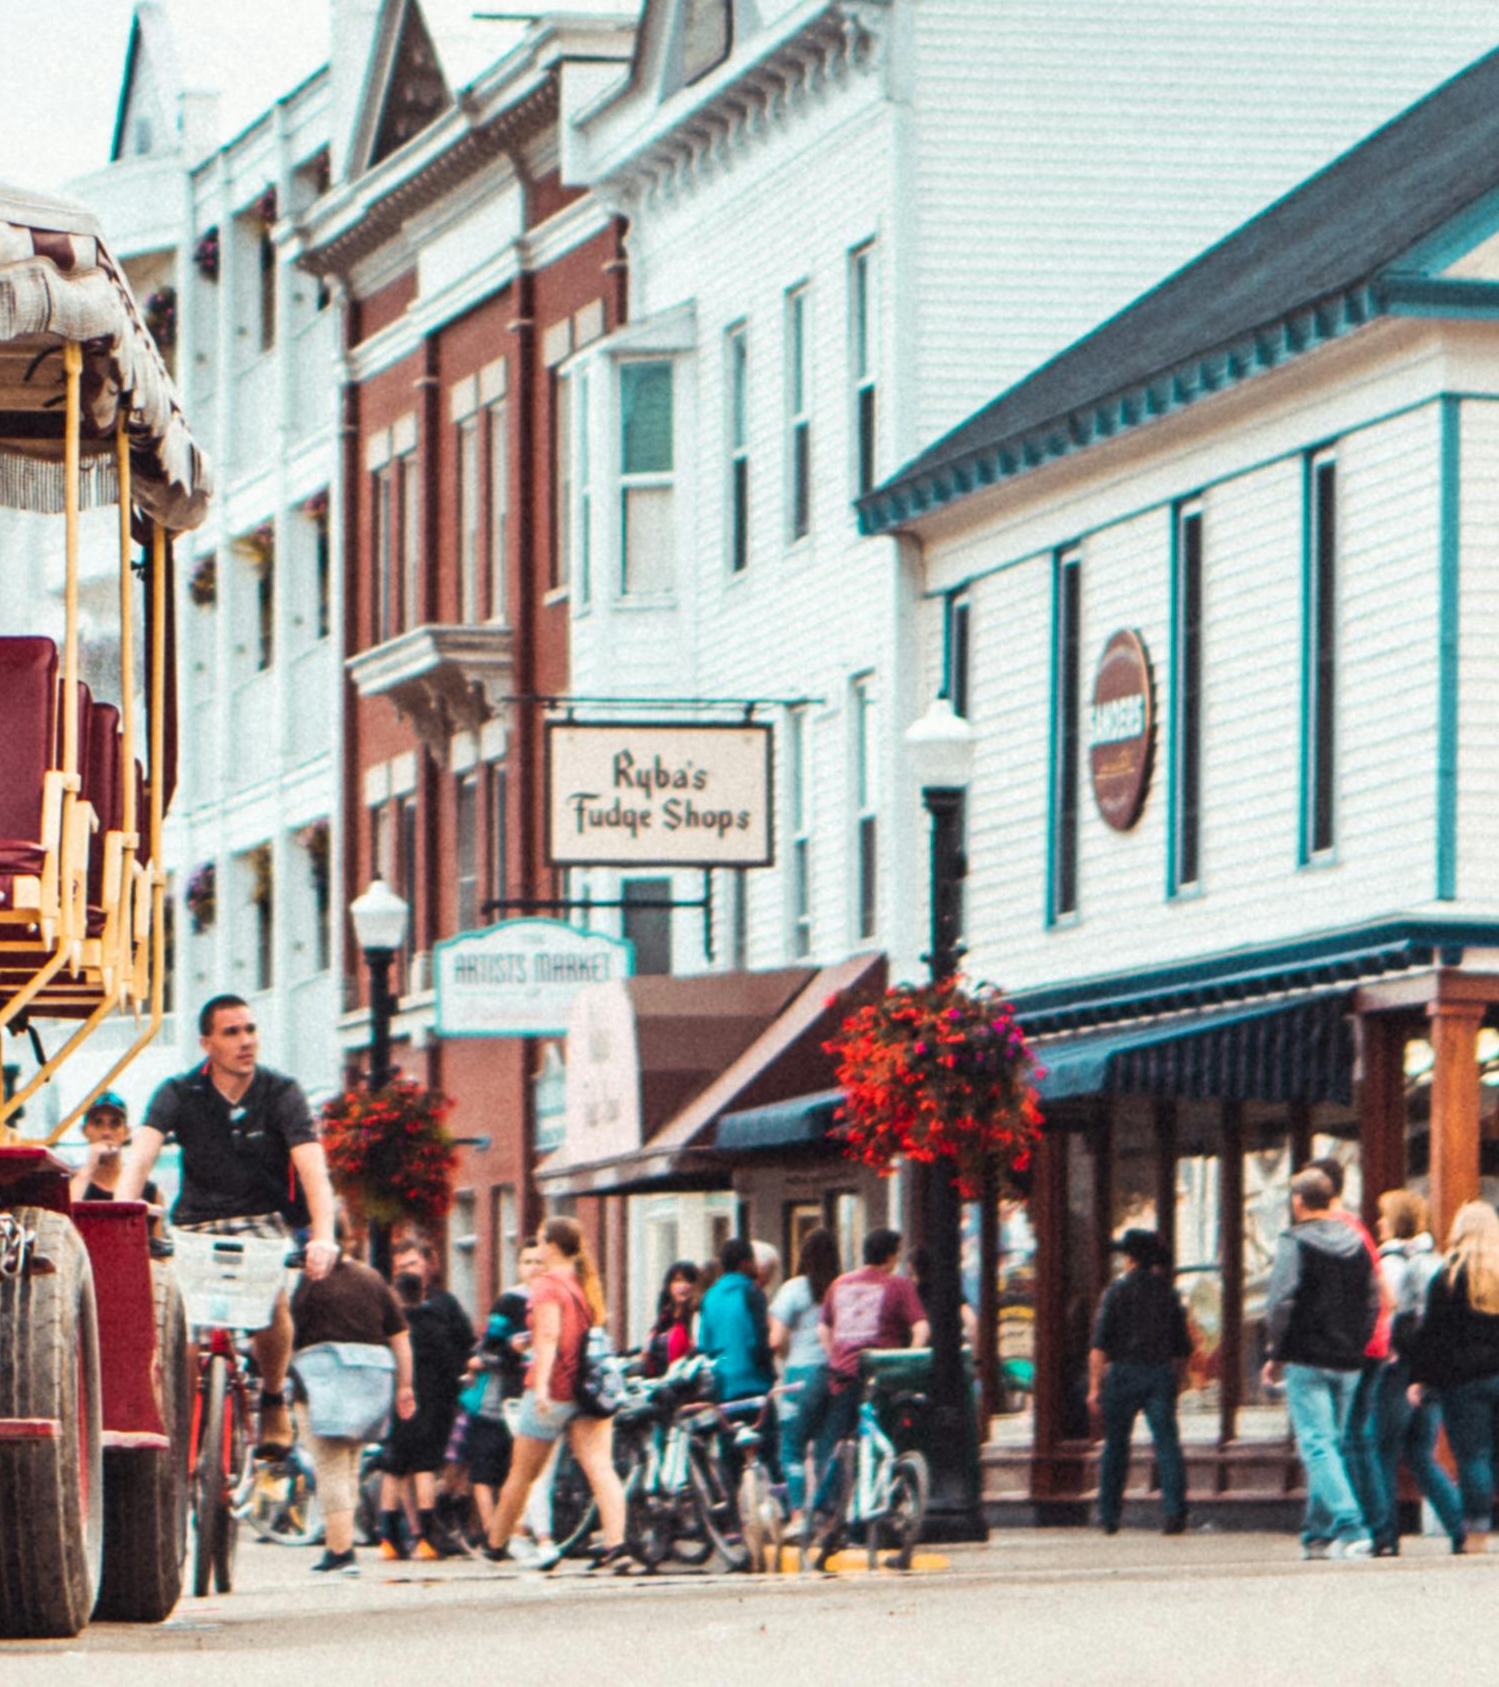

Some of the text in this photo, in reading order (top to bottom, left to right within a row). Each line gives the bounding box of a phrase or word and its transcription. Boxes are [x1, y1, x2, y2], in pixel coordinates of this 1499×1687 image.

[613, 748, 709, 800] Ryba's
[567, 792, 751, 839] Fudge Shops
[454, 952, 612, 984] ARTISTS MARKET
